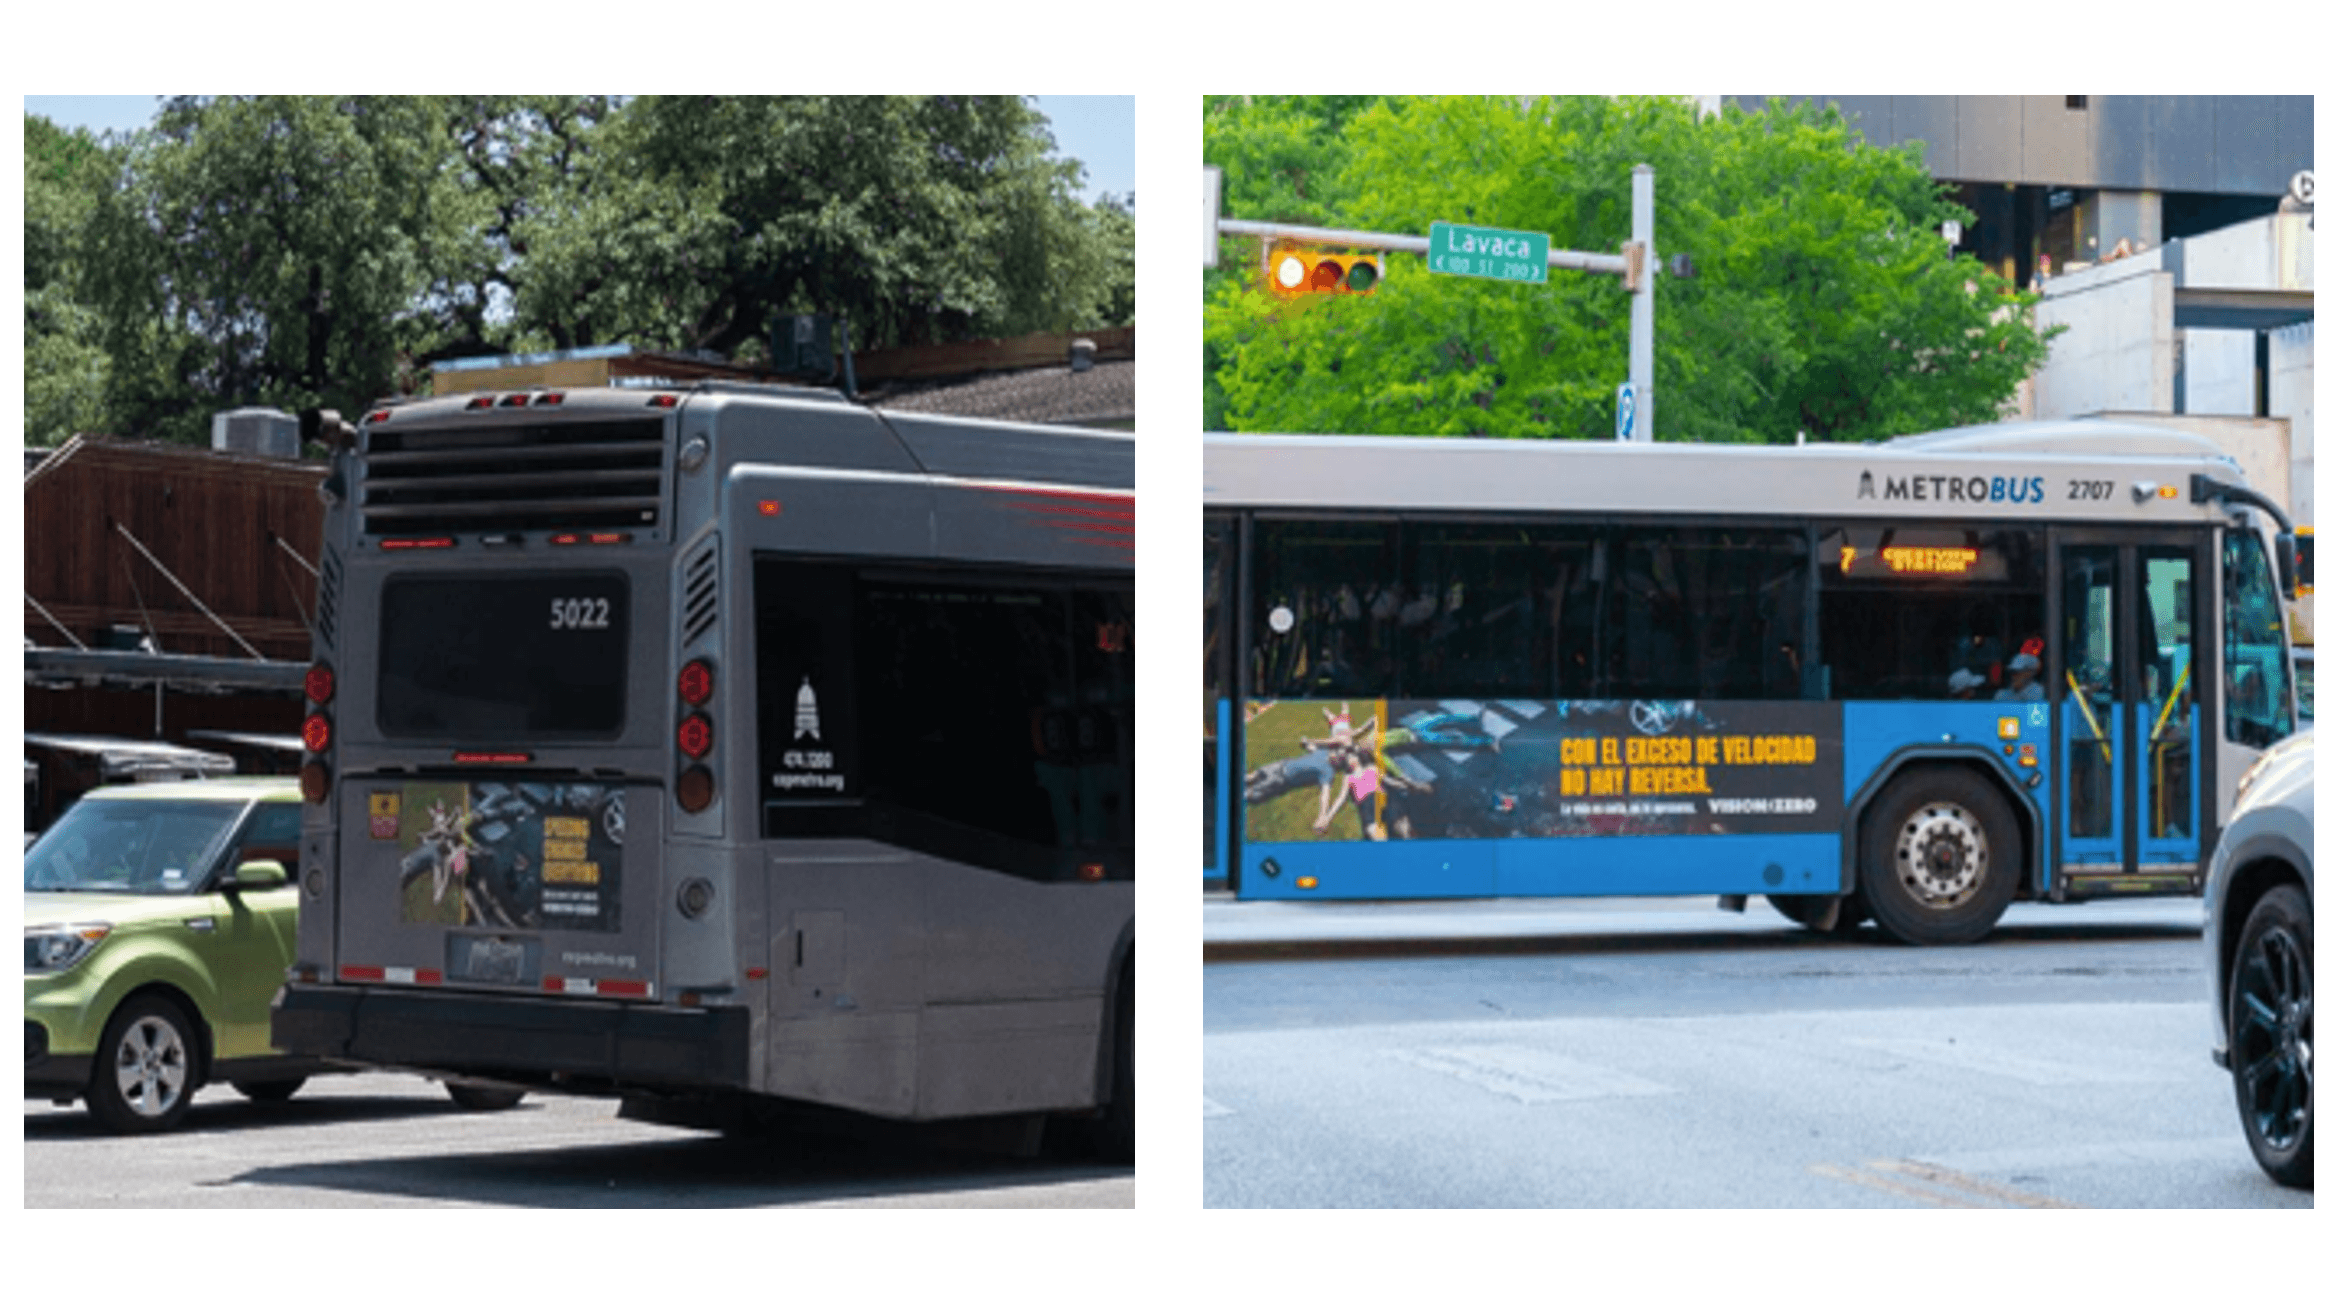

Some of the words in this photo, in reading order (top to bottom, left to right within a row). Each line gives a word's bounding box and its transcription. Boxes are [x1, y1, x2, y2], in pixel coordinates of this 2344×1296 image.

[1448, 226, 1531, 259] Lavaca
[1884, 475, 2045, 504] METROBUS
[2066, 480, 2116, 502] 2707
[1840, 546, 1856, 573] 7
[550, 597, 610, 630] 5022
[1560, 736, 1597, 765] CON
[1601, 736, 1622, 765] EL
[1625, 735, 1693, 765] EXCESO
[1696, 735, 1719, 765] DE
[1722, 735, 1817, 765] VELOCIDAD
[1560, 767, 1586, 795] NO
[1589, 767, 1626, 795] HAY
[1629, 767, 1714, 795] REVERSA.
